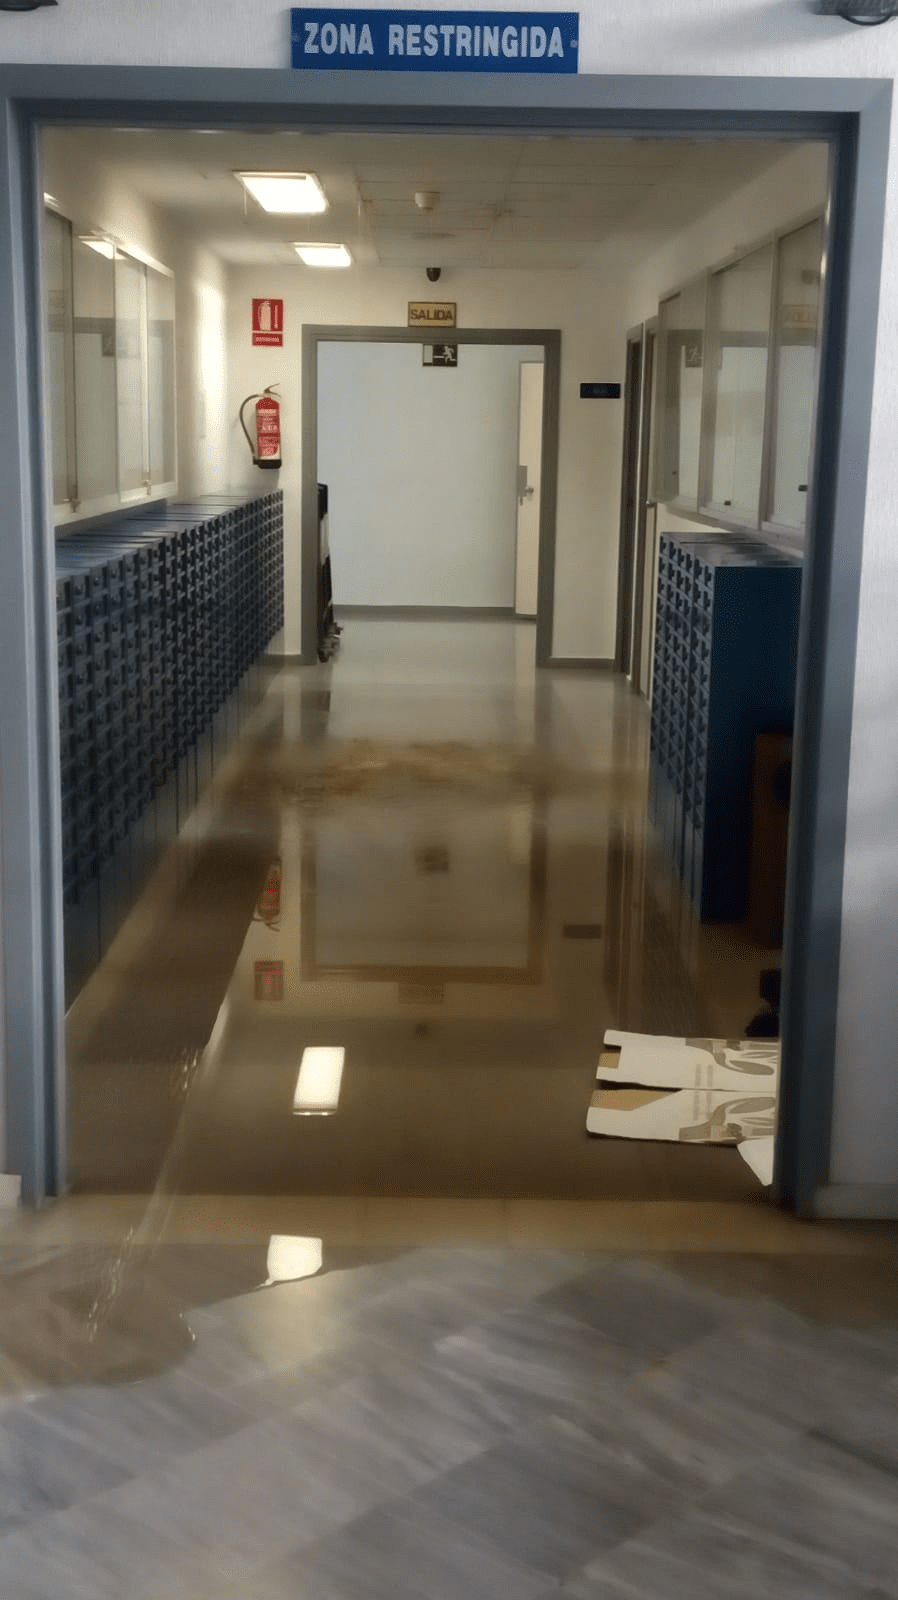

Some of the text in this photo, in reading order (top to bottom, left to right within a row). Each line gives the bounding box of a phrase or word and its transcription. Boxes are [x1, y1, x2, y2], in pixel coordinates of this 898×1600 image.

[304, 22, 564, 58] ZONA RESTRINGIDA
[410, 309, 453, 321] SALIDA
